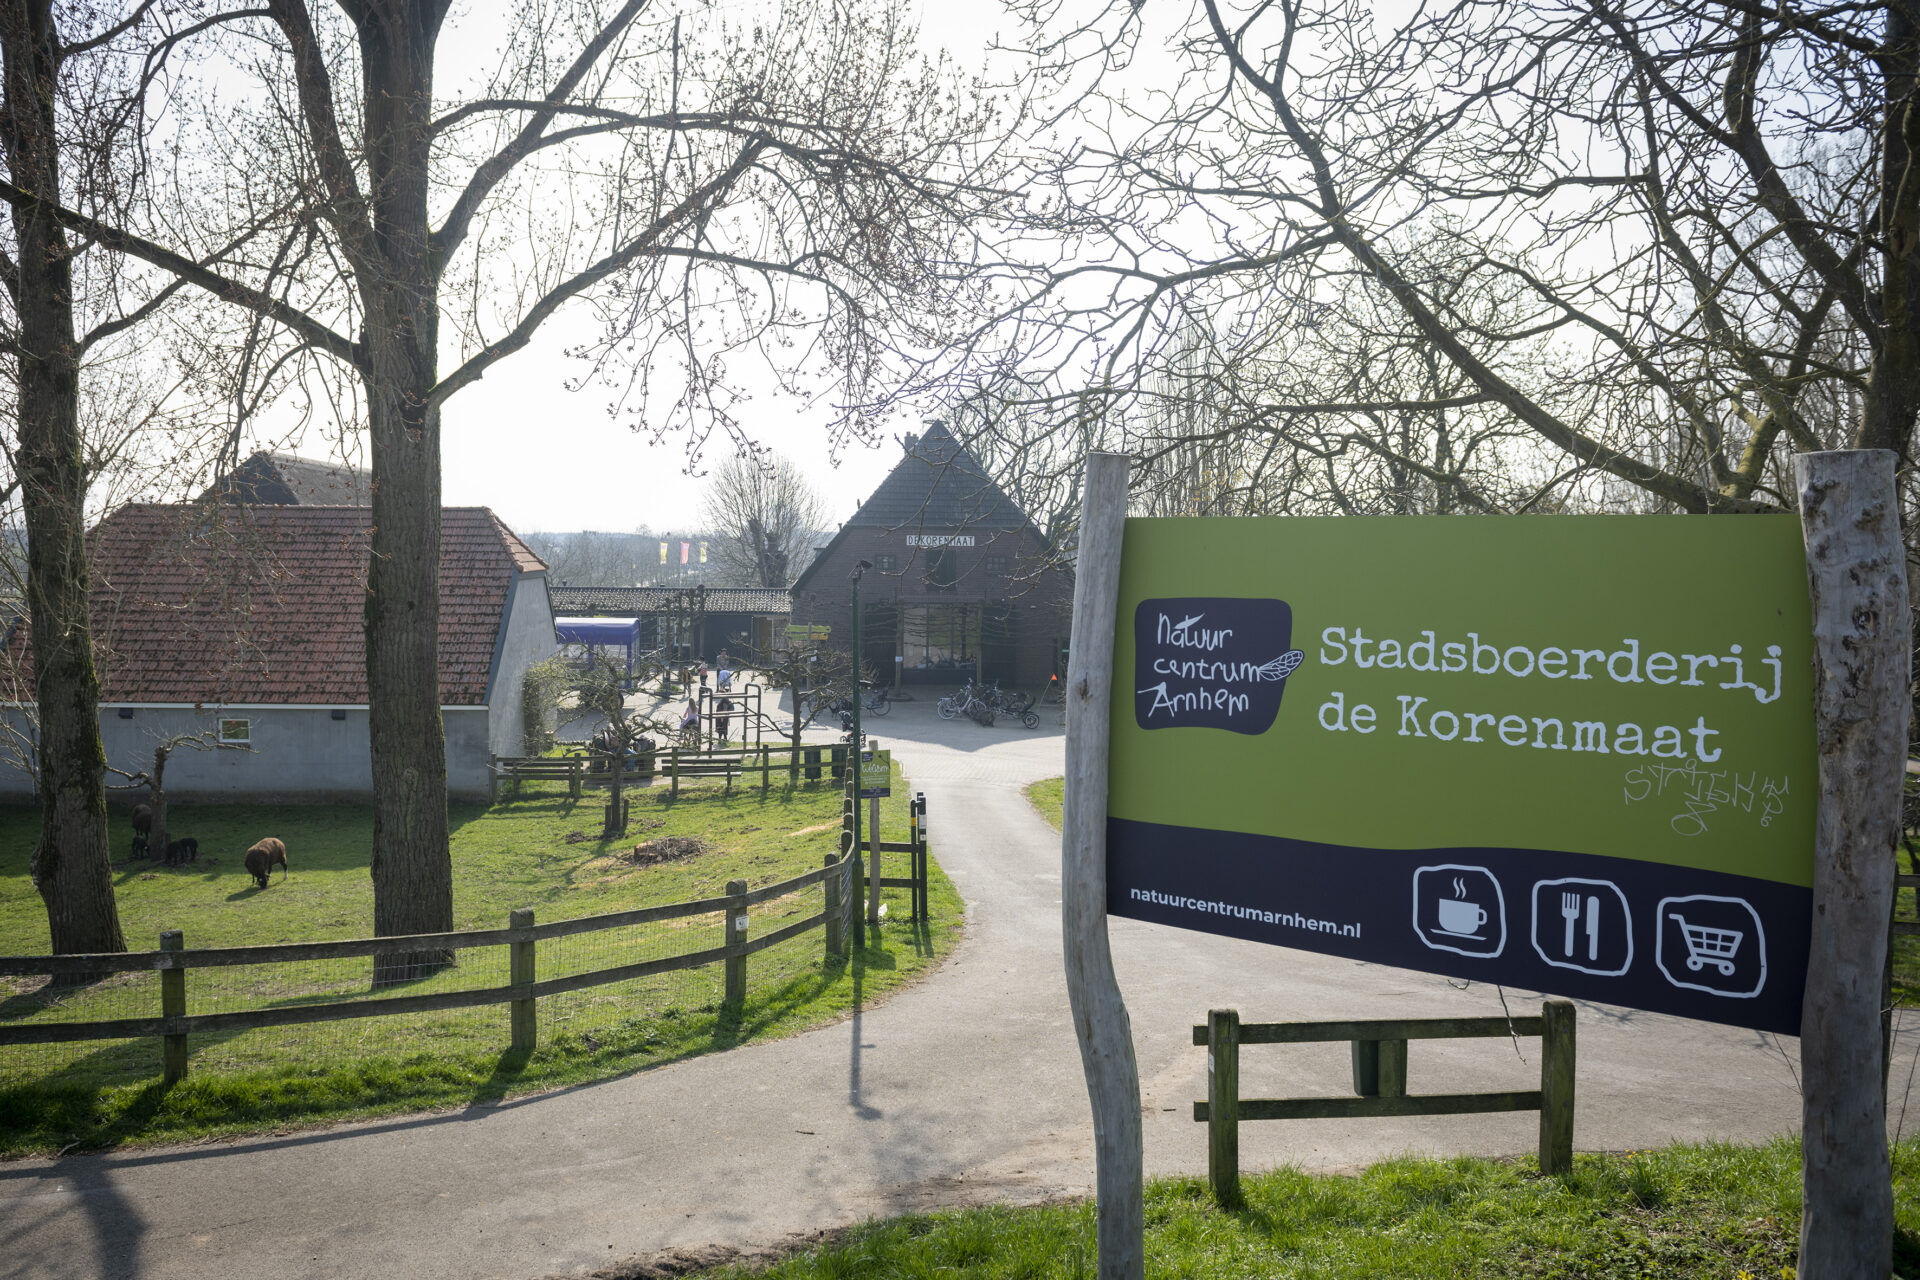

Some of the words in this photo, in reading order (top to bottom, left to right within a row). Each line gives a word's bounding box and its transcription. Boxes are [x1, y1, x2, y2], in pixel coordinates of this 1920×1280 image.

[1157, 612, 1233, 651] Natuur
[1153, 657, 1261, 683] centrum
[1320, 626, 1783, 704] Stadsboerderij
[1137, 681, 1250, 718] Arnhem
[1318, 691, 1377, 733] de
[1396, 694, 1723, 763] Korenmaat
[1130, 887, 1362, 939] natuurcentrumarnhem.nl
